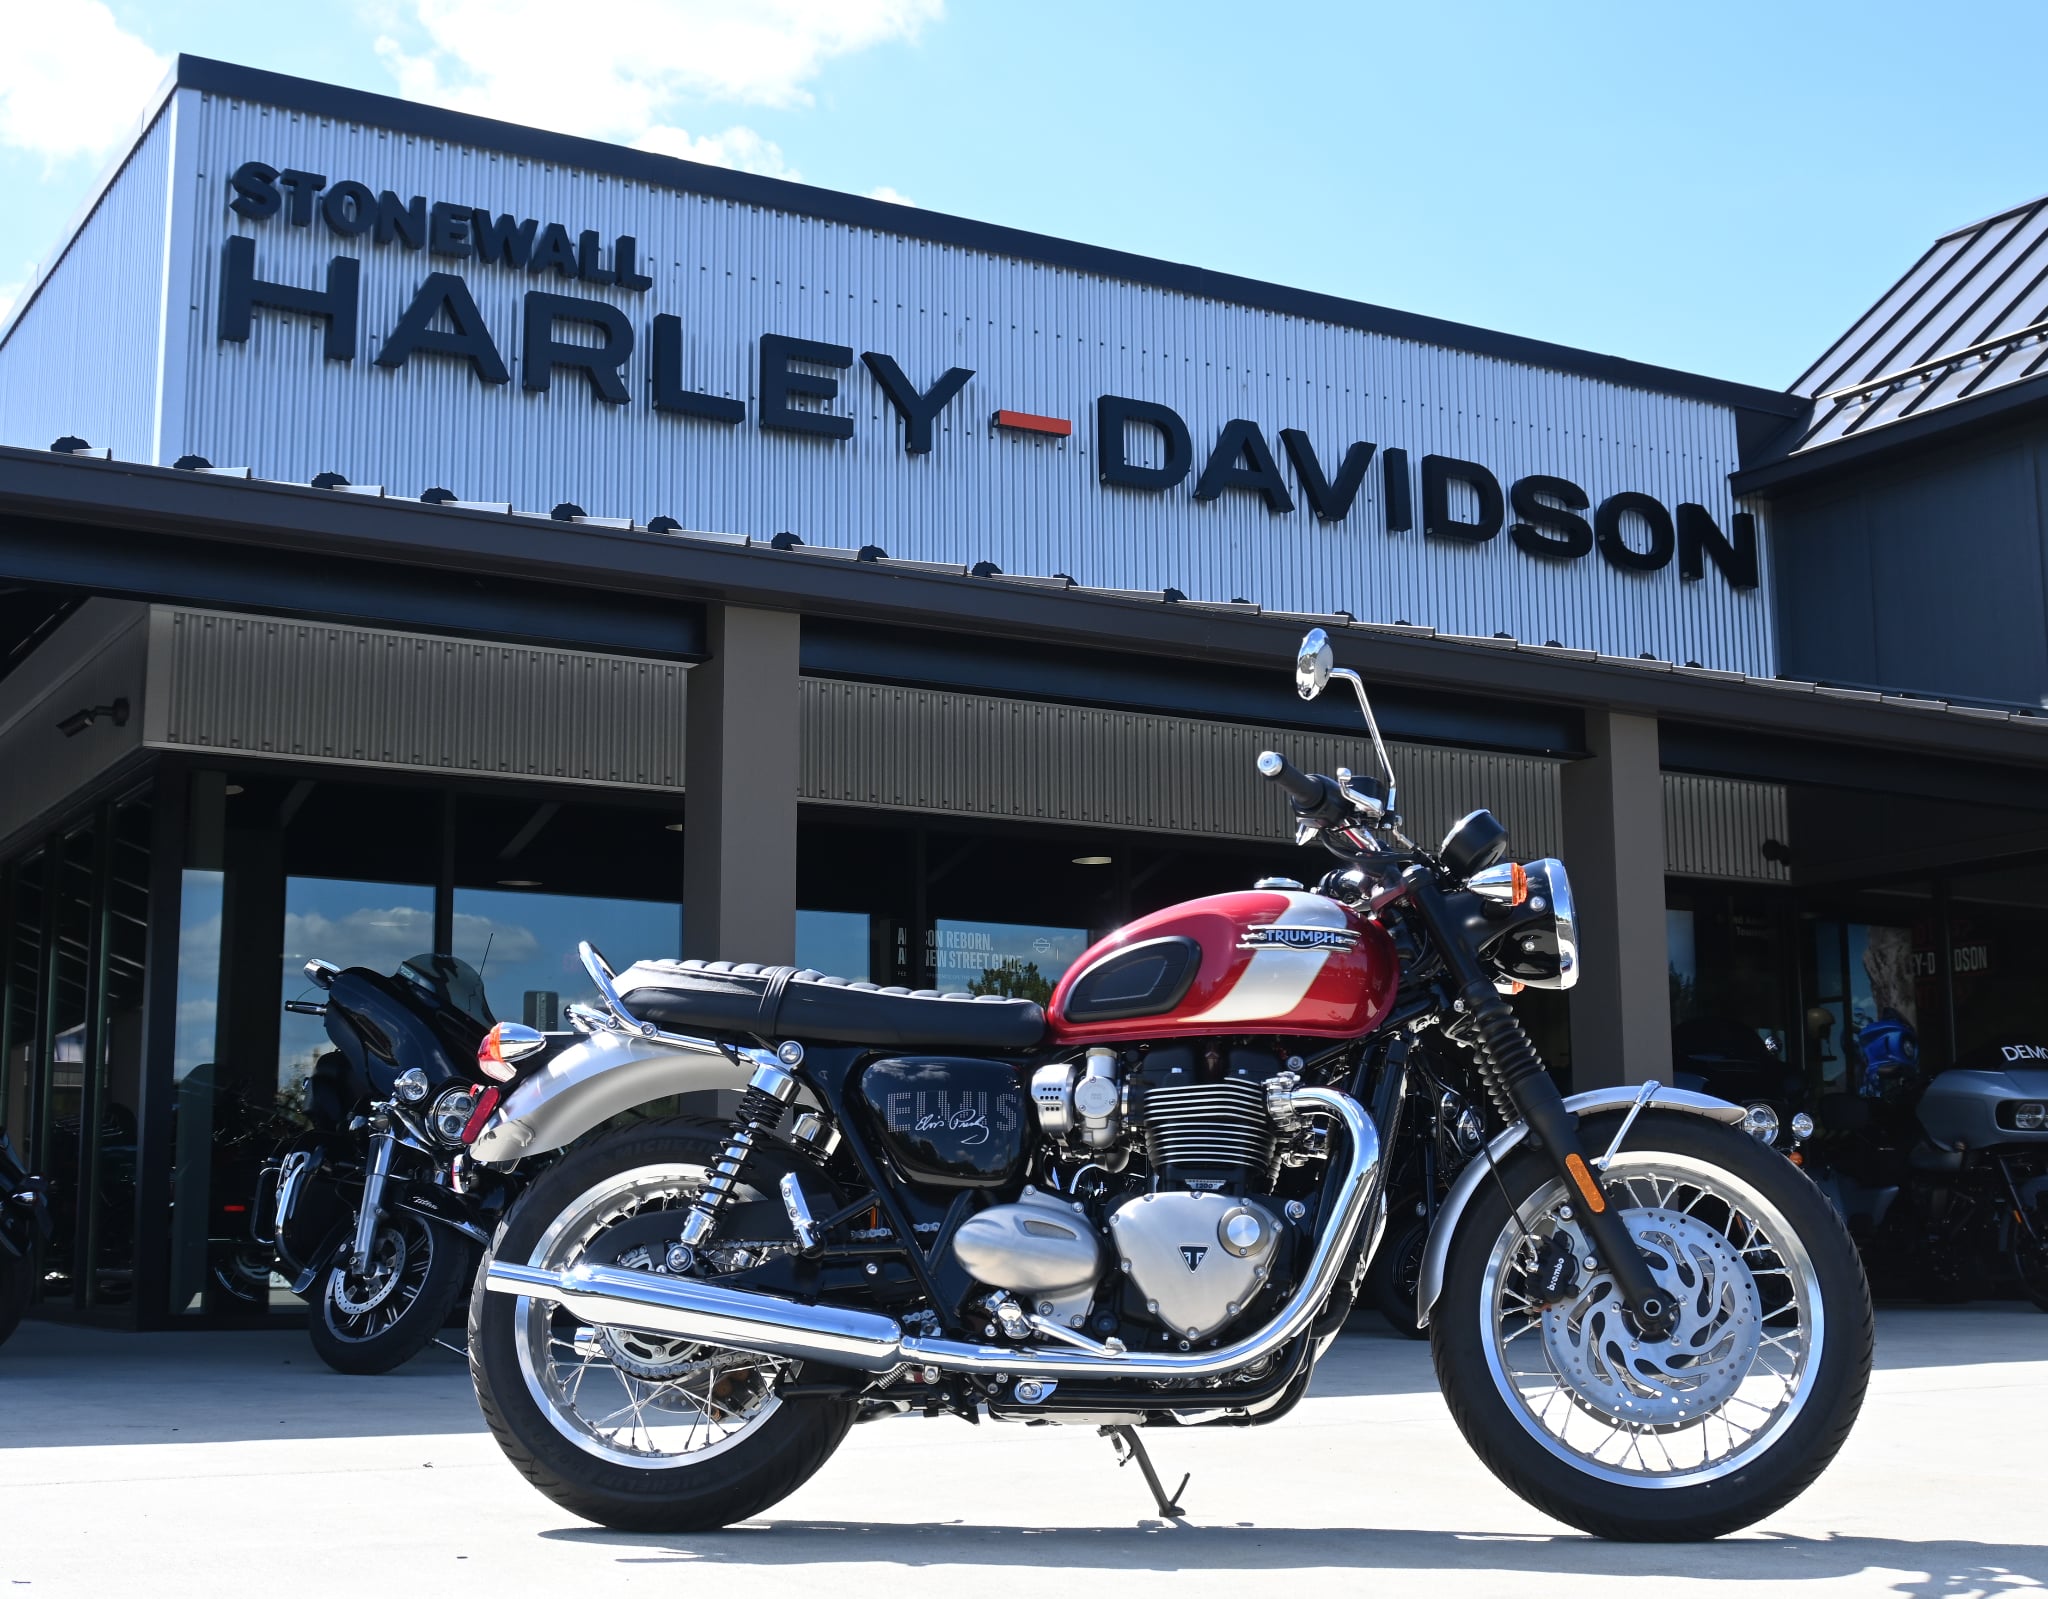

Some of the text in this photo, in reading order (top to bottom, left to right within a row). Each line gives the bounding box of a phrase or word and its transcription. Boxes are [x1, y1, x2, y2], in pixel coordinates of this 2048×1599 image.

[230, 161, 652, 291] STONEWALL
[946, 931, 994, 951] REBORN.
[1265, 929, 1336, 945] TRIUMPH
[949, 951, 990, 970] STREET
[1546, 1257, 1565, 1292] brembo
